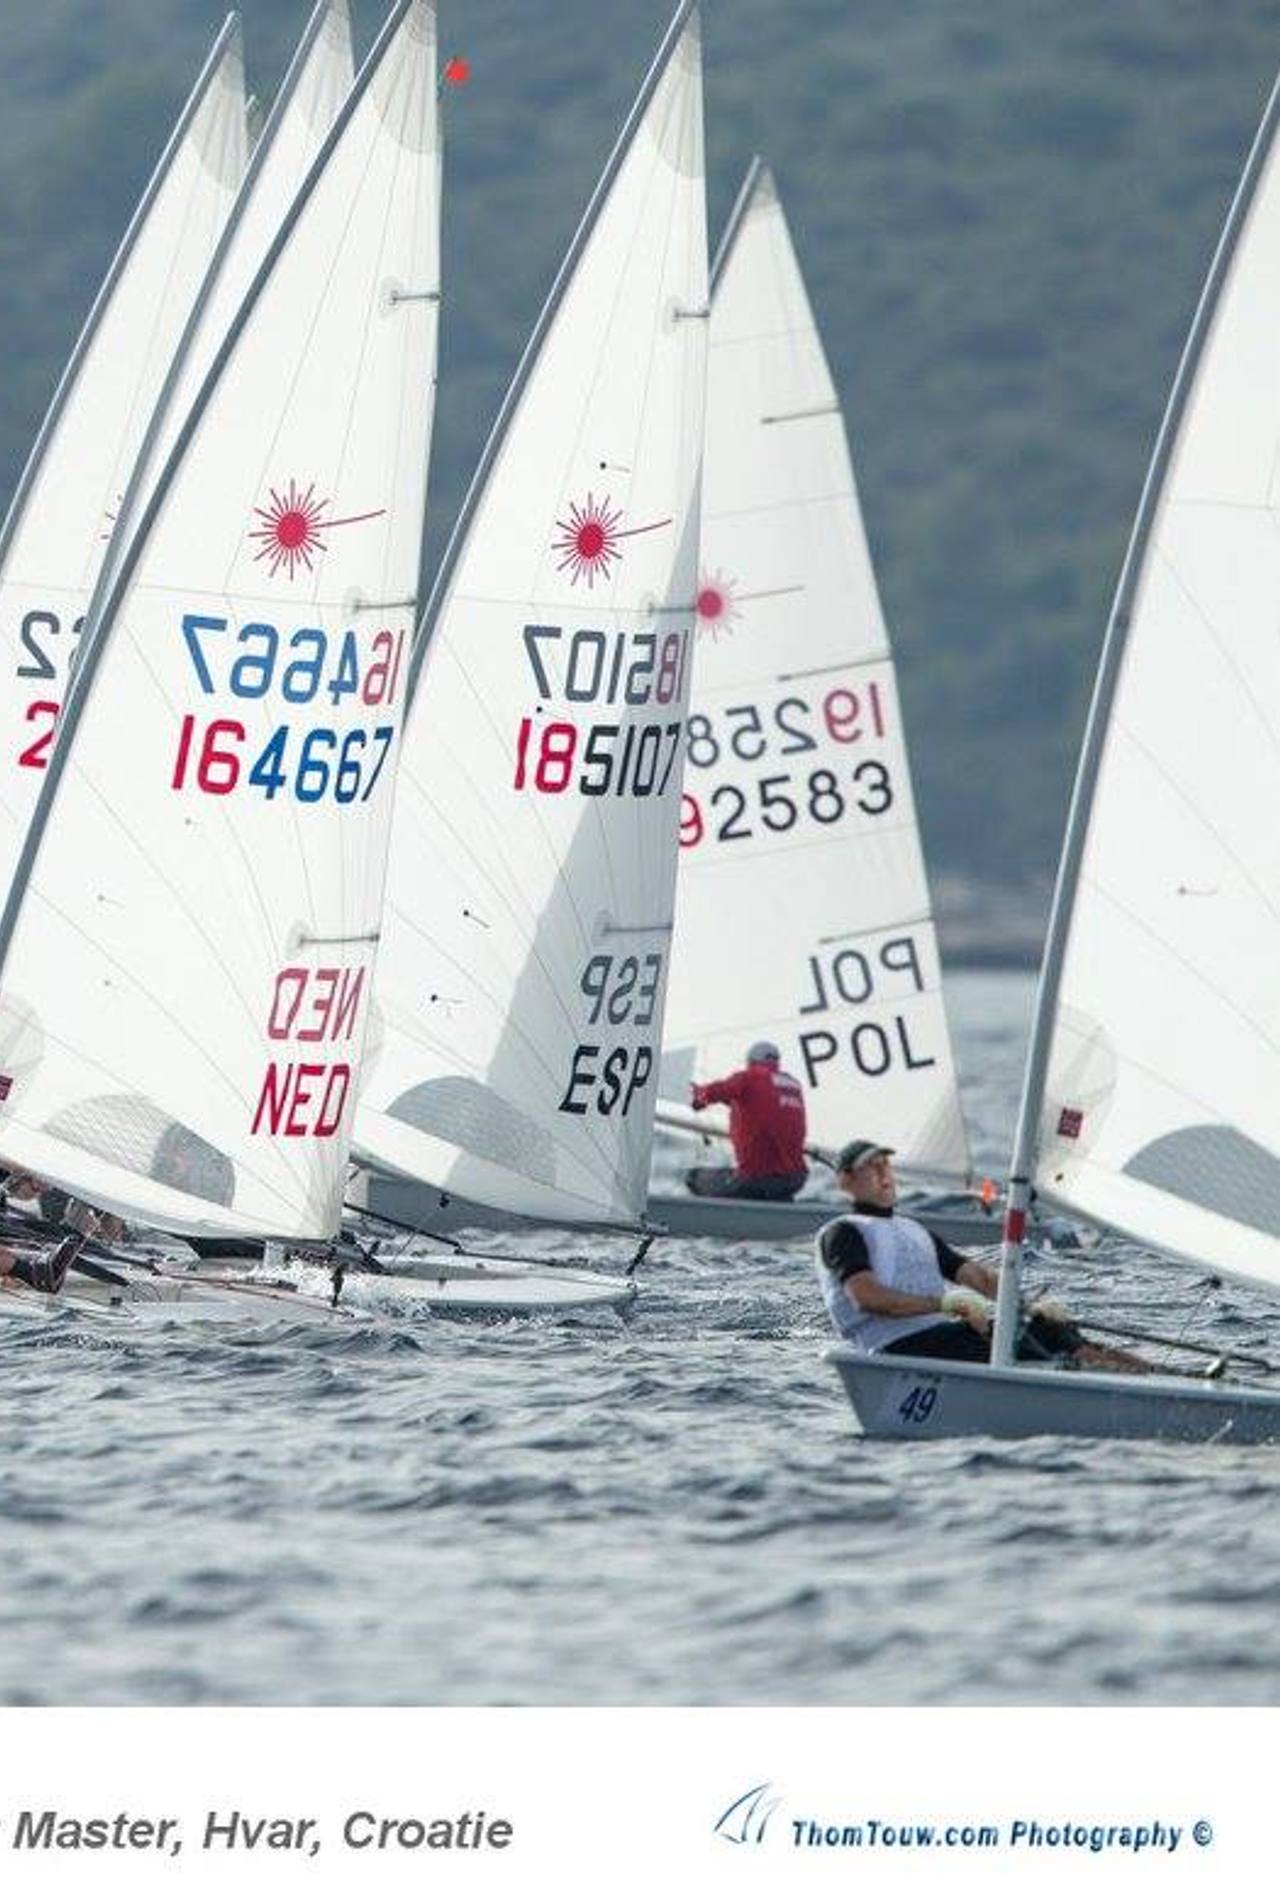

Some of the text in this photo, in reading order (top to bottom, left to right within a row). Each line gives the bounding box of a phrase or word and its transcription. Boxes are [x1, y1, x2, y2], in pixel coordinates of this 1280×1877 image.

[171, 714, 394, 804] 164667
[514, 718, 681, 798] 185107
[679, 760, 893, 848] 92583
[559, 1044, 654, 1117] ESP
[799, 1016, 935, 1088] POL
[251, 1063, 351, 1138] NED
[899, 1386, 938, 1424] 49
